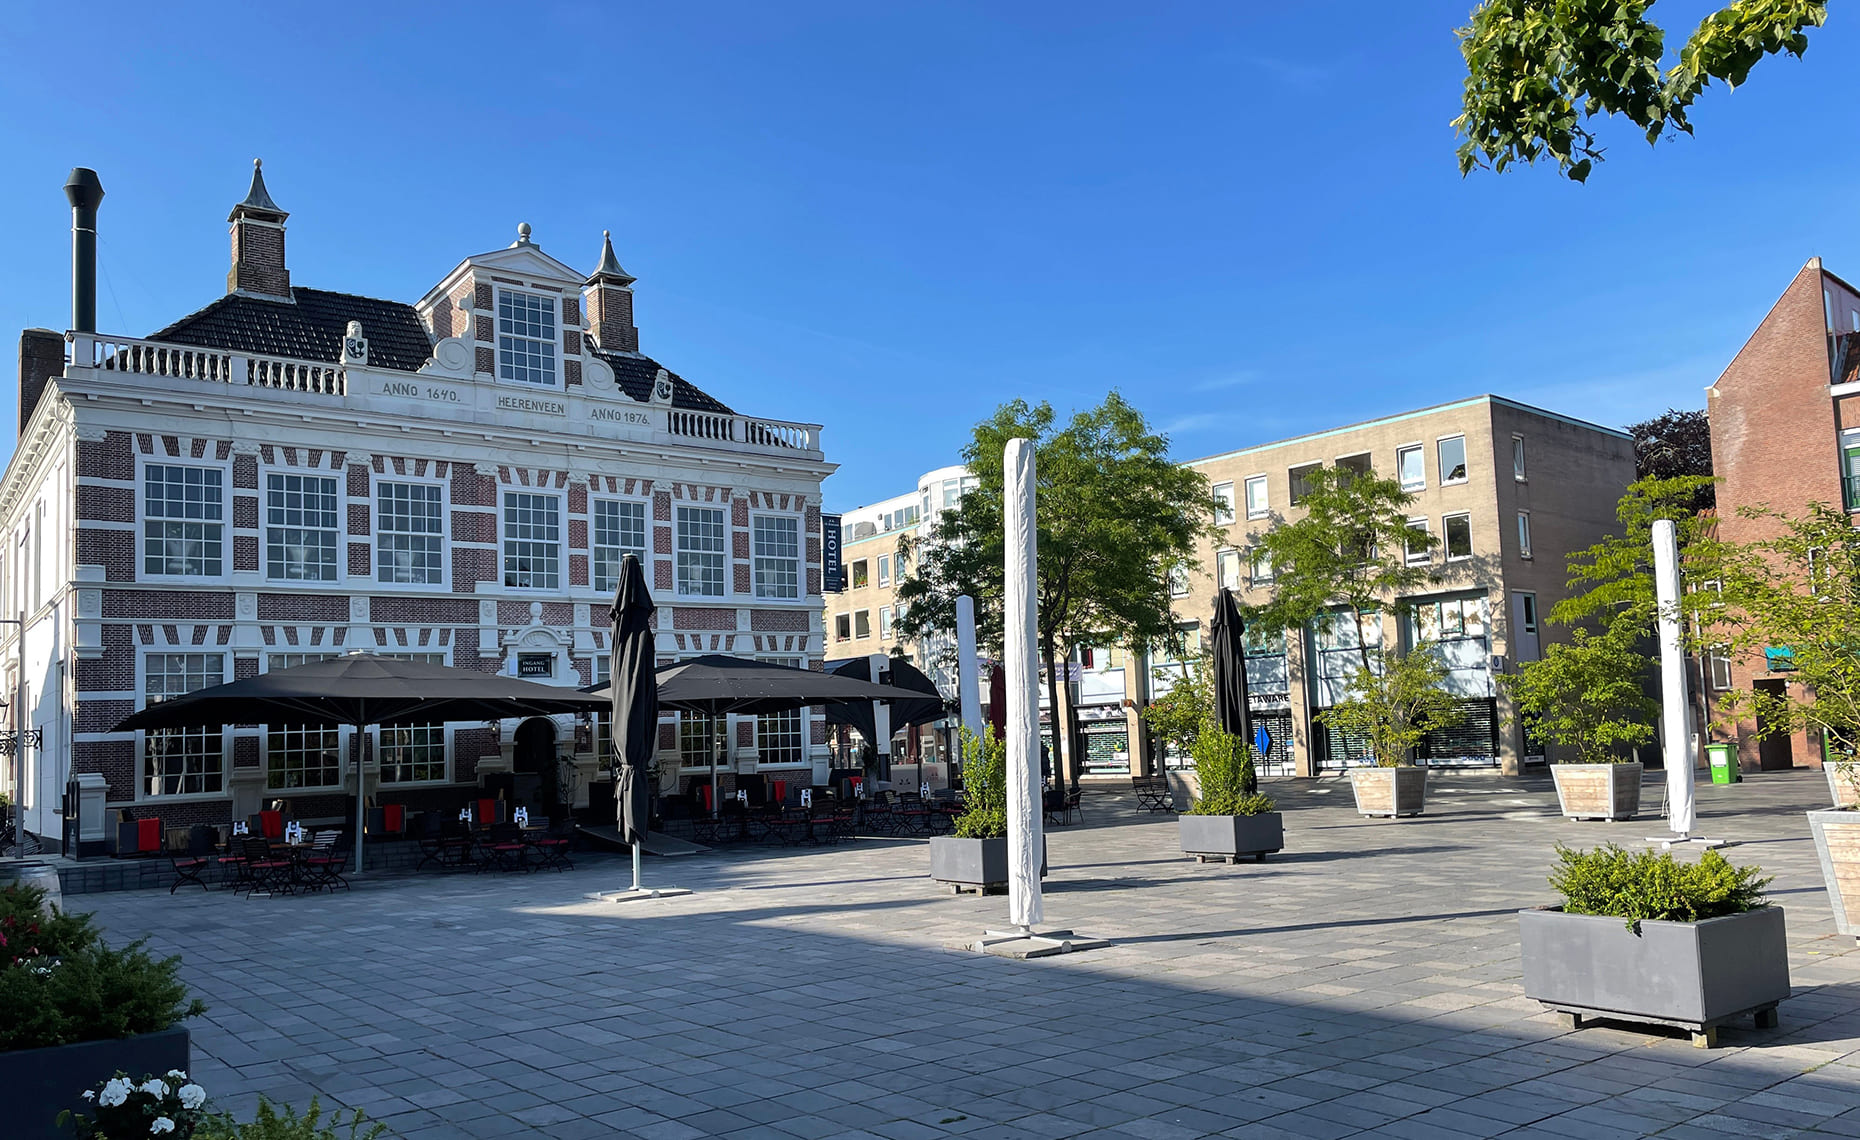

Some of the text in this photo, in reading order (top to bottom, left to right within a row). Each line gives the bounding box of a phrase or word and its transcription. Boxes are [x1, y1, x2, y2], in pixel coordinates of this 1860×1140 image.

[383, 383, 418, 397] ANNO
[498, 396, 565, 414] HEERENVEEN
[591, 408, 622, 421] ANNO
[827, 529, 837, 574] HOTEL
